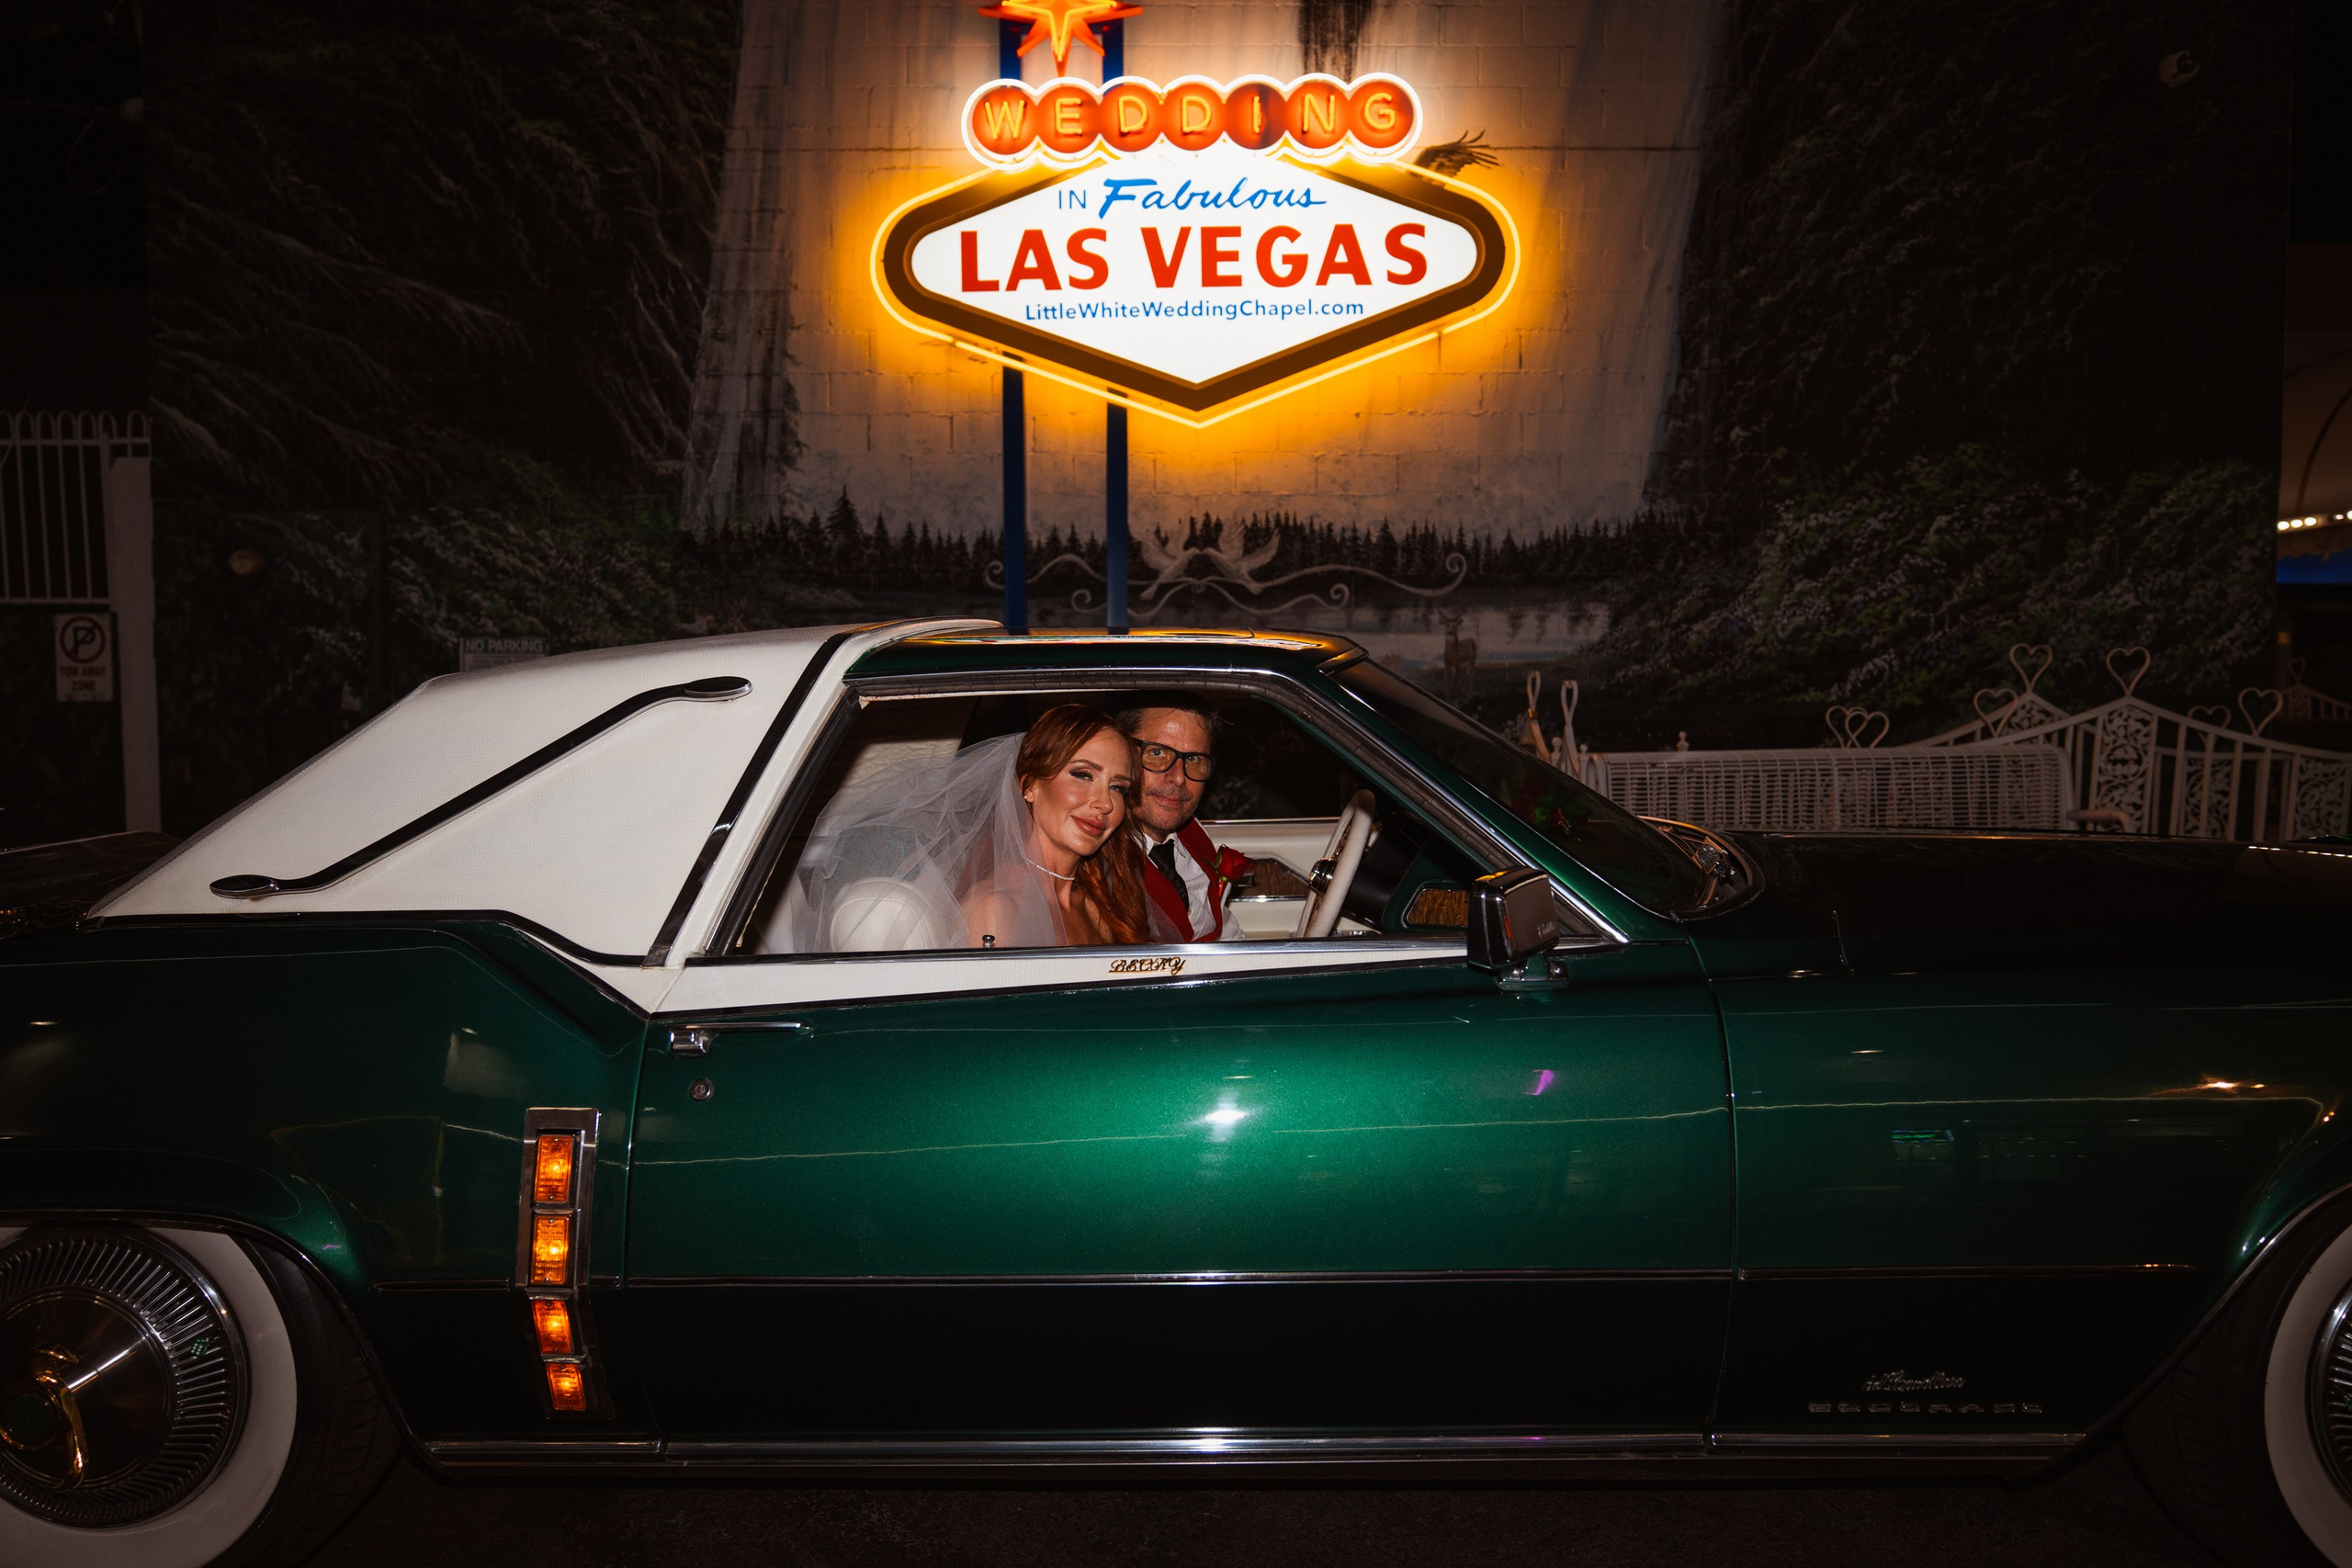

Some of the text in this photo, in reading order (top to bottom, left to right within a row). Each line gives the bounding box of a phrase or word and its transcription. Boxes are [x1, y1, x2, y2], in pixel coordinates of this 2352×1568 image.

[984, 92, 1396, 140] WEDDING
[1058, 176, 1327, 220] IN Fabulous
[960, 223, 1428, 292] LAS VEGAS
[1025, 299, 1363, 321] LittleWhiteWeddingChapel.com
[466, 638, 543, 652] NO PARKING
[1108, 956, 1186, 976] BECKY
